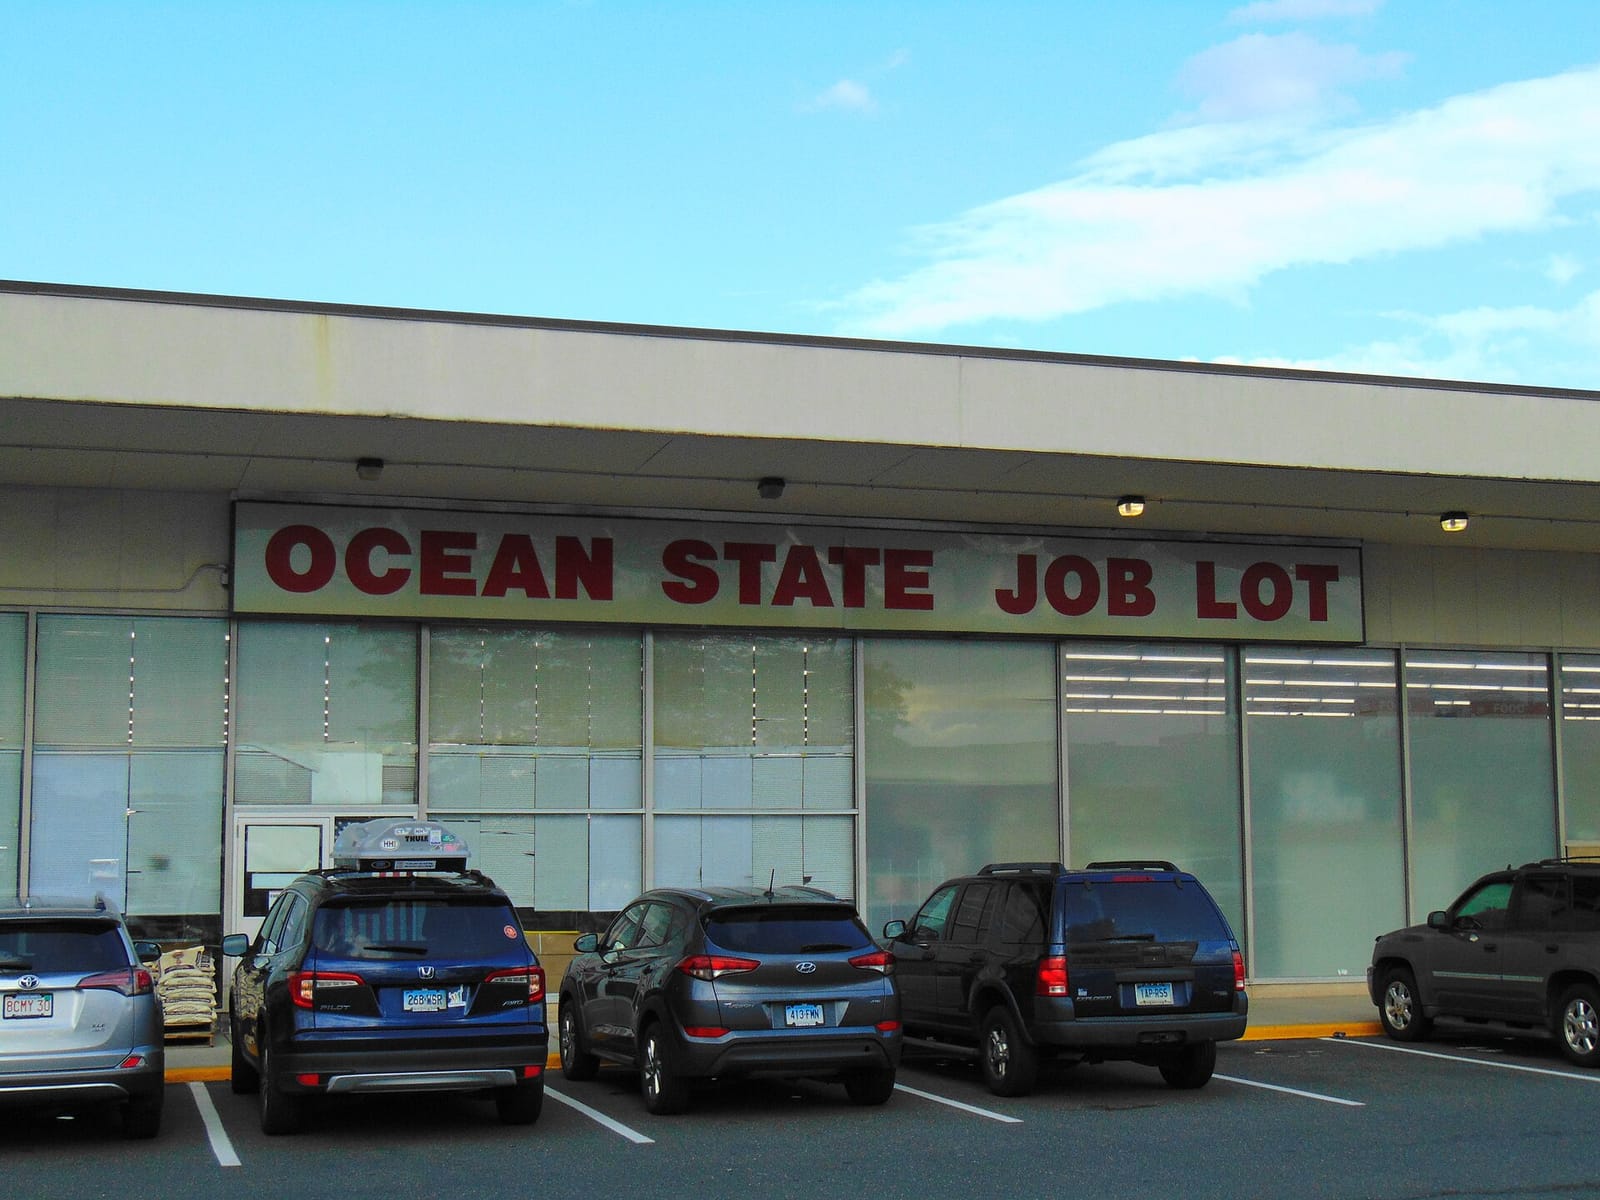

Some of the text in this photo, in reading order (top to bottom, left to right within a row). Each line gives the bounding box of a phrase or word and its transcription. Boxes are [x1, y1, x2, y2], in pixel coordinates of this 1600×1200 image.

[265, 524, 1339, 622] OCEAN STATE JOB LOT
[6, 999, 50, 1013] 8CMY 30
